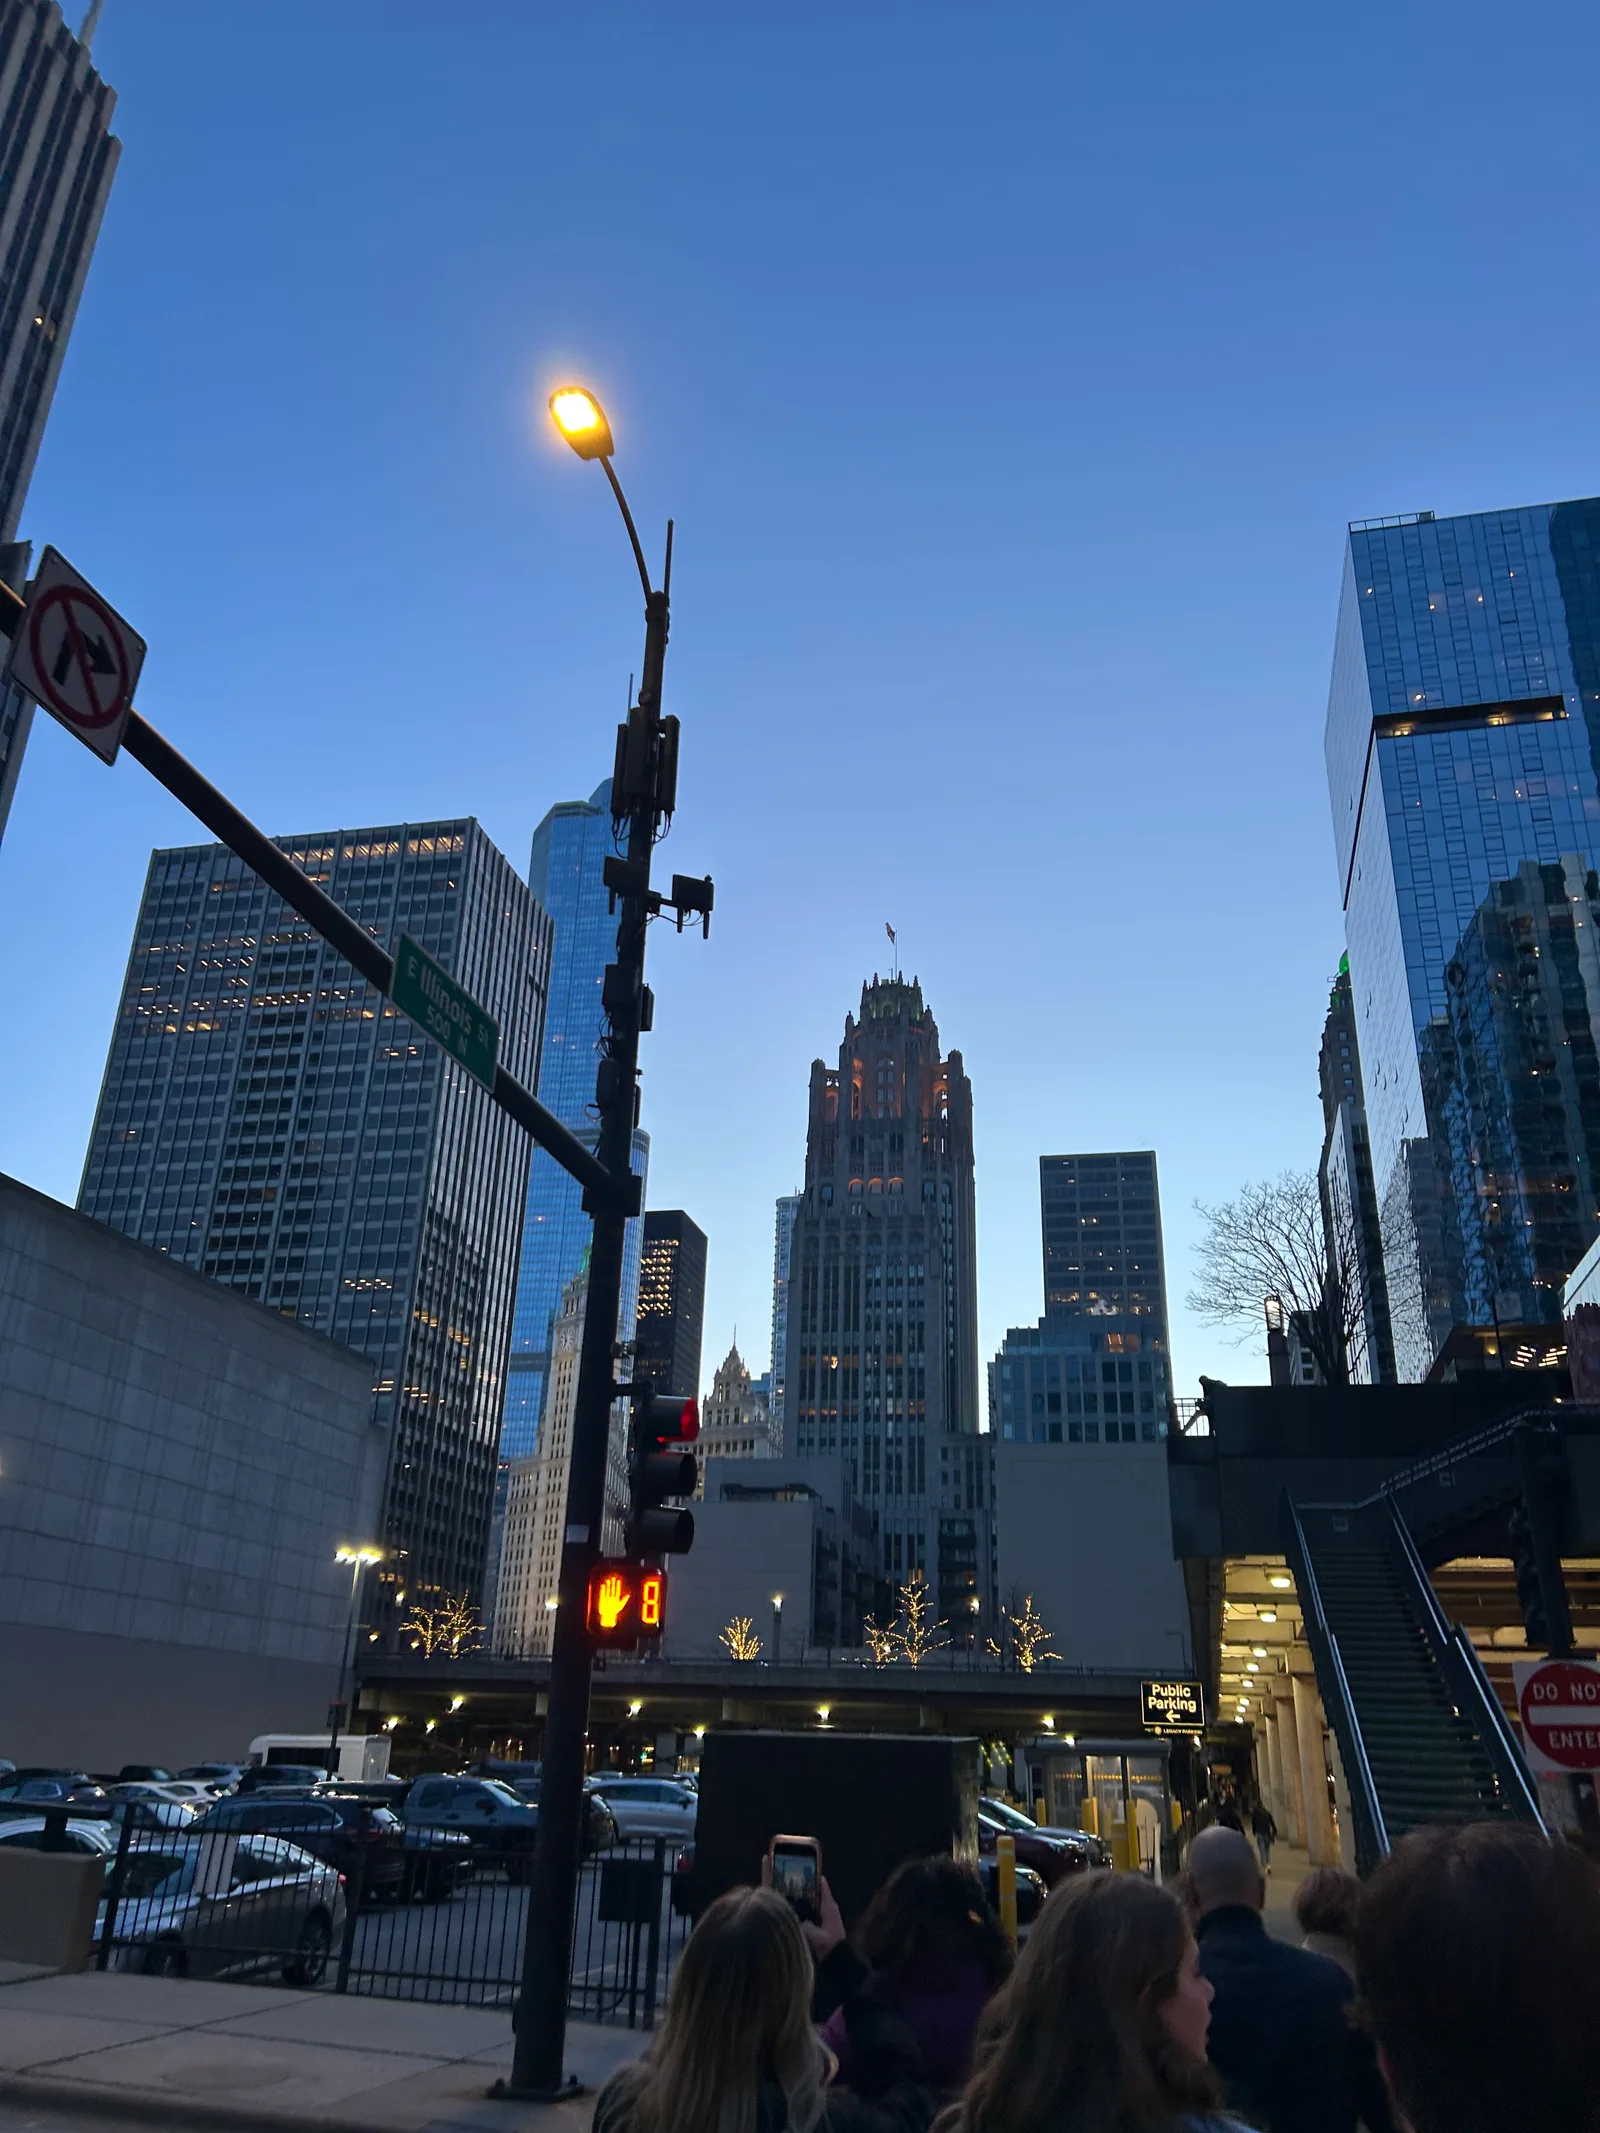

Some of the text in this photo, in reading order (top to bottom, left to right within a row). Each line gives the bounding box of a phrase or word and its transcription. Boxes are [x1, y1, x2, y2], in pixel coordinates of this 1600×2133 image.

[408, 955, 418, 978] E
[420, 964, 472, 1035] Illinois
[426, 1005, 451, 1040] 500
[641, 1581, 659, 1624] 8
[1151, 1684, 1191, 1698] Public
[1533, 1682, 1558, 1700] DO
[1147, 1696, 1197, 1713] Parking
[1549, 1730, 1600, 1749] ENTE
